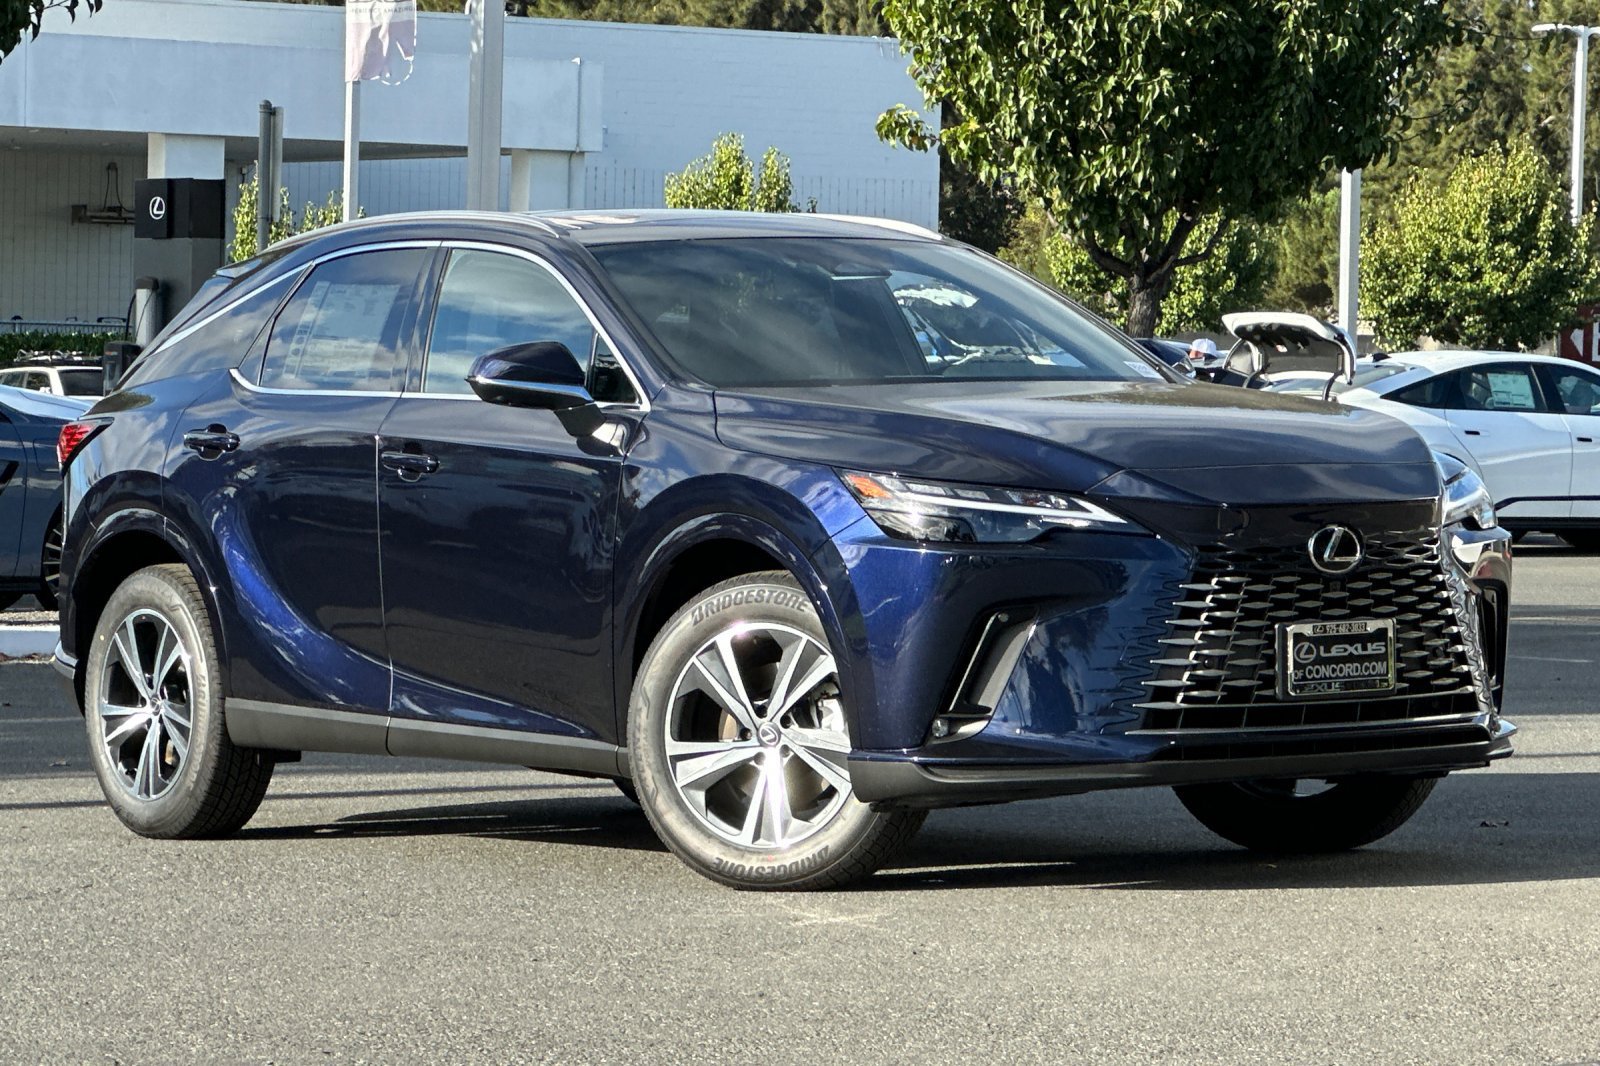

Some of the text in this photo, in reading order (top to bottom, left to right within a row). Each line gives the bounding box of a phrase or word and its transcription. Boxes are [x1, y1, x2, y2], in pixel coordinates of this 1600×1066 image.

[691, 589, 809, 627] BRIDGESTONE
[1320, 643, 1386, 656] LEXUS
[1293, 662, 1386, 680] OF CONCORD.COM
[712, 844, 830, 881] BRIDGESTONE
